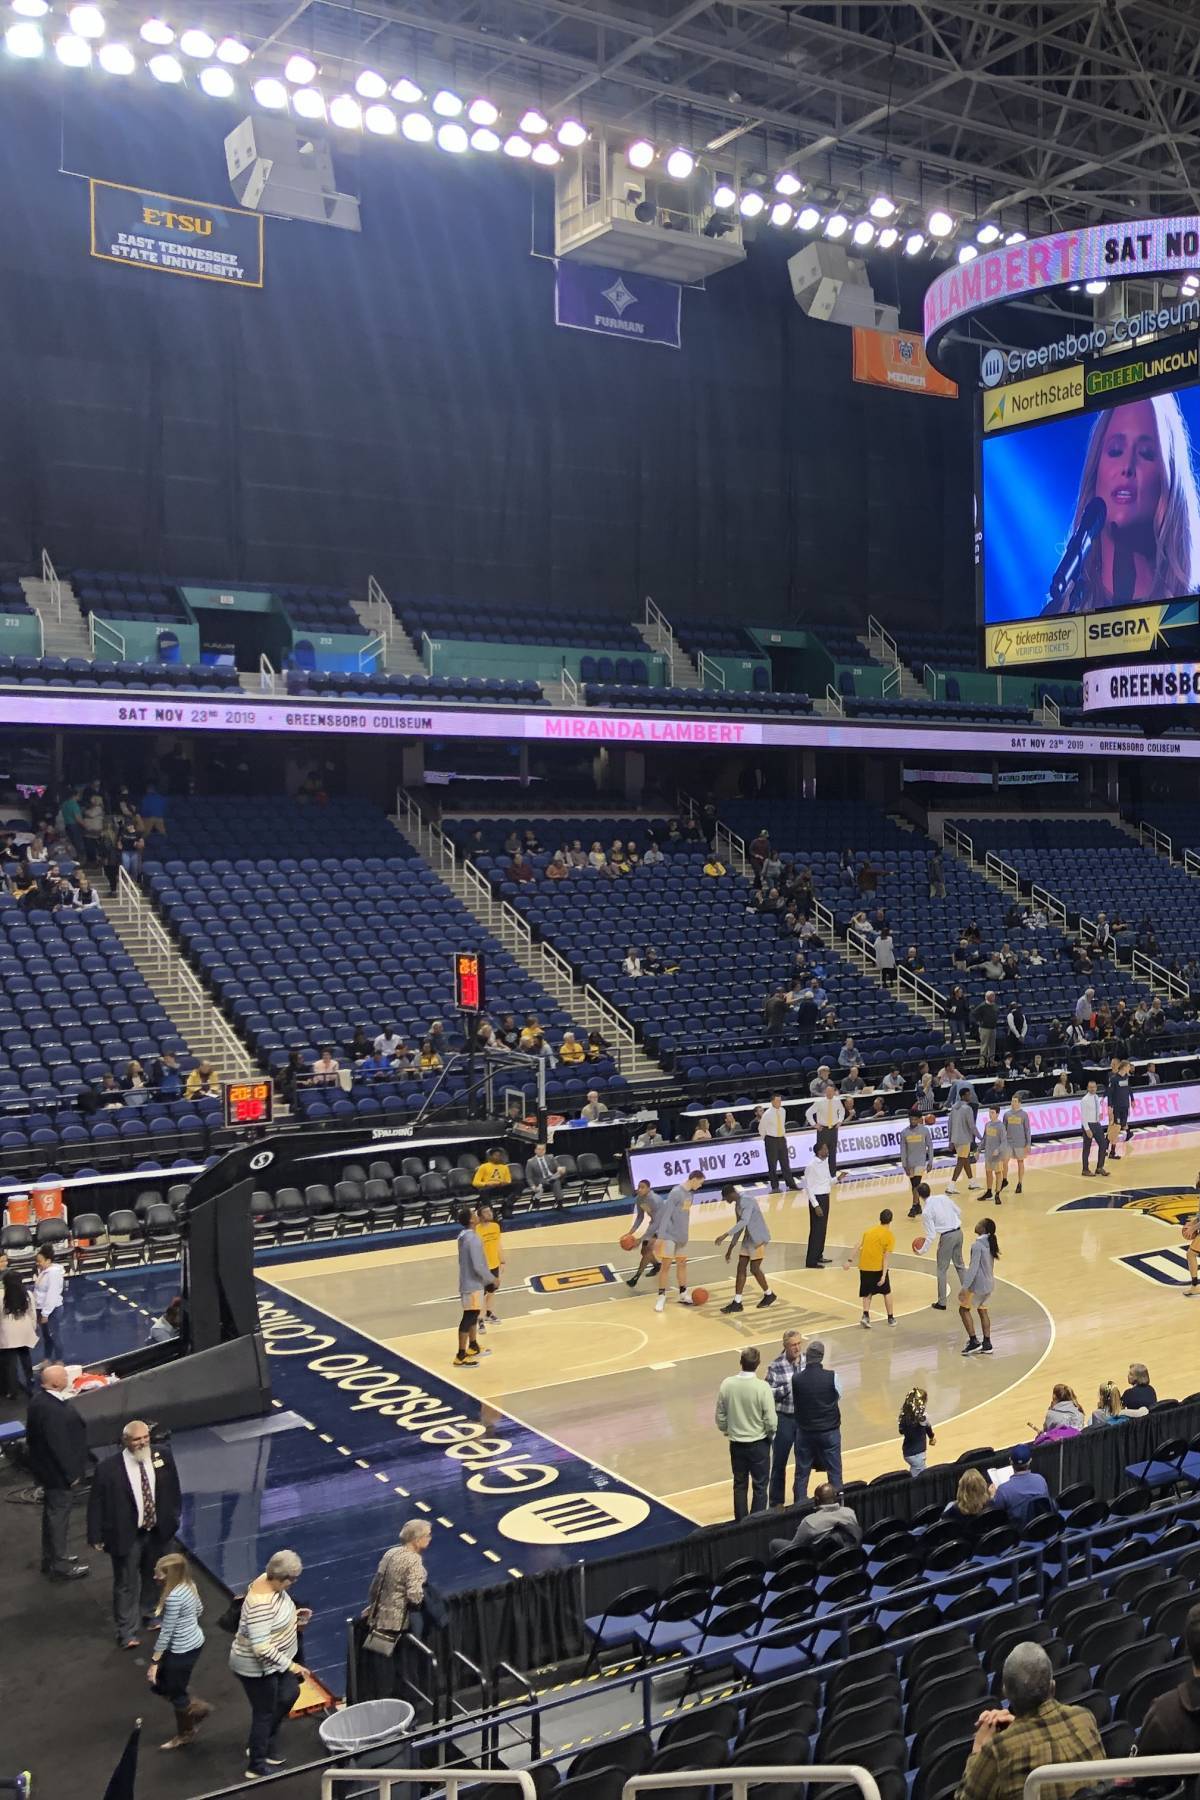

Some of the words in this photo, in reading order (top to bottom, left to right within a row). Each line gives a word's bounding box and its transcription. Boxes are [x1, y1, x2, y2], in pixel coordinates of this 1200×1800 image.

[142, 207, 212, 236] ETSU
[118, 232, 155, 250] EAST
[158, 241, 238, 266] TENNESSEE
[111, 244, 158, 263] STATE
[162, 253, 244, 279] UNIVERSITY
[937, 235, 1079, 321] LAMBERT
[1104, 235, 1152, 264] SAT
[594, 315, 645, 333] FURMAN
[1007, 328, 1107, 373] Greensboro
[1113, 300, 1200, 342] Coliseum
[1087, 362, 1145, 395] GREEN
[1145, 349, 1198, 378] LINCOLN
[1012, 381, 1082, 414] NorthState
[4, 618, 20, 627] 213
[1088, 617, 1150, 640] SEGRA
[1015, 627, 1072, 646] ticketmaster
[1015, 644, 1043, 657] VERIFIED
[1044, 641, 1070, 654] TICKETS
[118, 707, 148, 721] SAT
[155, 709, 184, 722] NOV
[225, 711, 256, 724] 2019
[286, 713, 367, 728] GREENSBORO
[373, 716, 433, 729] COLISEUM
[546, 719, 644, 739] MIRANDA
[651, 722, 745, 743] LAMBERT
[1011, 738, 1027, 748] SAT
[1030, 739, 1045, 749] NOV
[1067, 740, 1084, 750] 2019
[1100, 742, 1144, 752] GREENSBORO
[1147, 743, 1181, 753] COLISEUM
[230, 1084, 268, 1101] 20:13
[236, 1100, 263, 1120] 30
[372, 1126, 414, 1139] SPALDING
[663, 1156, 691, 1177] SAT
[699, 1153, 727, 1172] NOV
[307, 1353, 560, 1494] Greensboro
